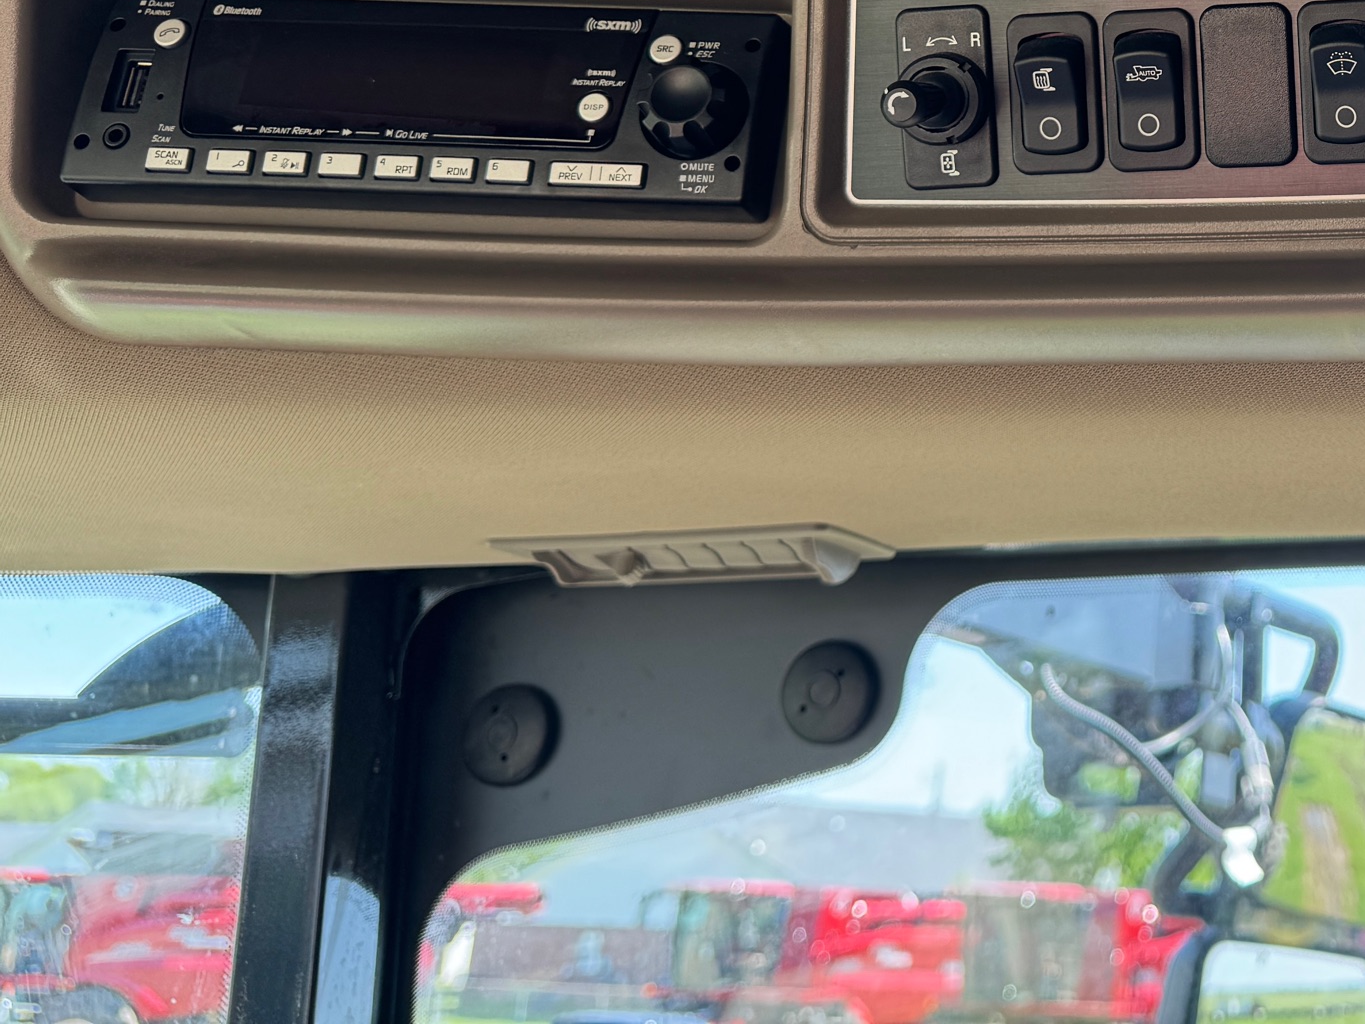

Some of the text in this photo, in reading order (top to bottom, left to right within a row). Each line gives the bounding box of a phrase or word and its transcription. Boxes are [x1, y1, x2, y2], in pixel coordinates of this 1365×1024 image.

[223, 6, 262, 16] Bluetooth
[902, 36, 911, 52] L
[970, 32, 981, 47] R
[656, 44, 675, 53] SRC
[697, 41, 721, 50] PWR
[695, 50, 716, 58] ESC
[583, 103, 605, 111] DISP
[154, 149, 179, 159] SCAN
[271, 153, 278, 162] 2
[165, 158, 183, 166] ASCN
[326, 156, 333, 165] 3
[379, 158, 386, 166] 4
[436, 159, 442, 168] 5
[394, 166, 414, 175] RPT
[492, 162, 498, 171] 6
[688, 162, 715, 172] MUTE
[446, 167, 469, 176] RDM
[558, 172, 583, 181] PREV
[608, 173, 632, 182] NEXT
[687, 174, 715, 183] MENU
[693, 185, 709, 194] OK
